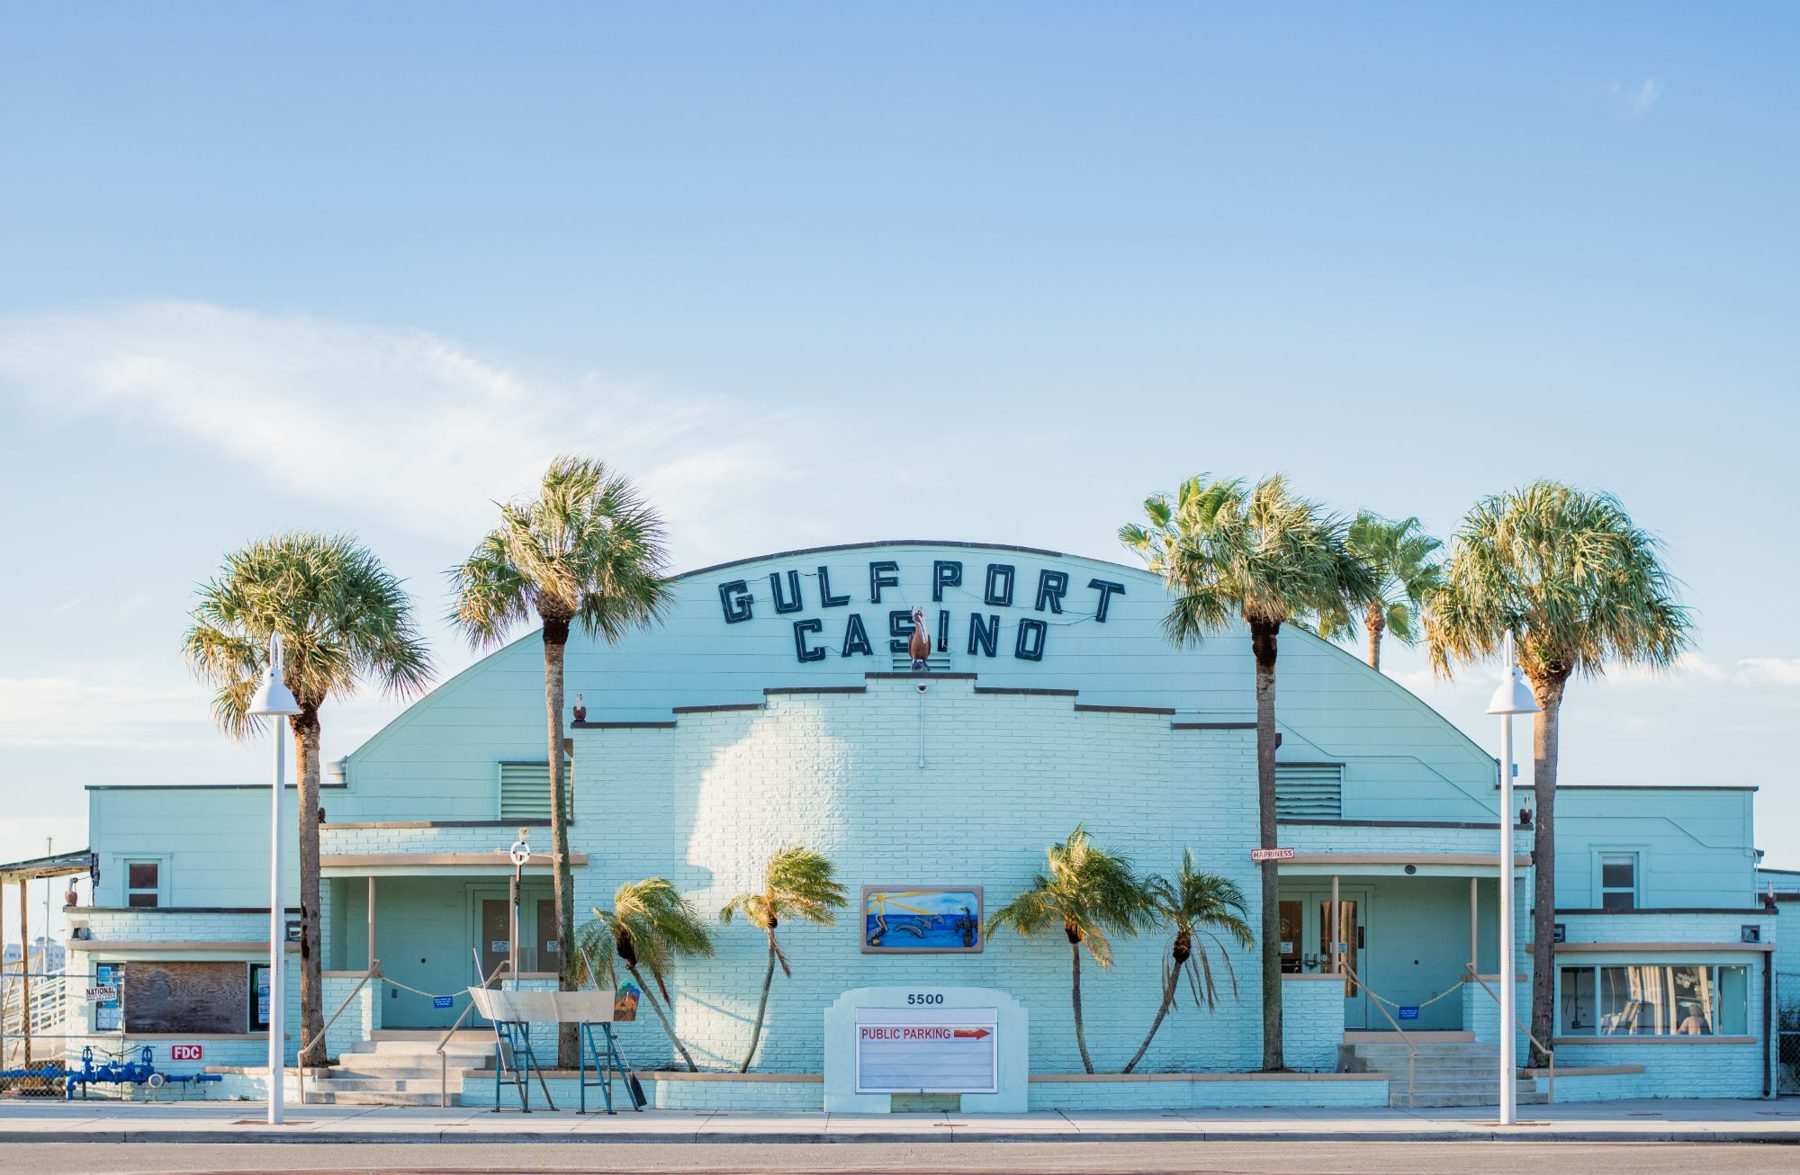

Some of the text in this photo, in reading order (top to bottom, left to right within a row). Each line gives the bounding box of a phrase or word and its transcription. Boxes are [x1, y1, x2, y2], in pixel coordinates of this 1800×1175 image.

[718, 560, 1126, 624] GULFPORT
[793, 609, 1047, 662] CASINO
[86, 987, 115, 995] NATIONAL
[907, 993, 944, 1005] 5500
[861, 1028, 951, 1040] PUBLIC PARKING
[174, 1046, 200, 1059] FDC
